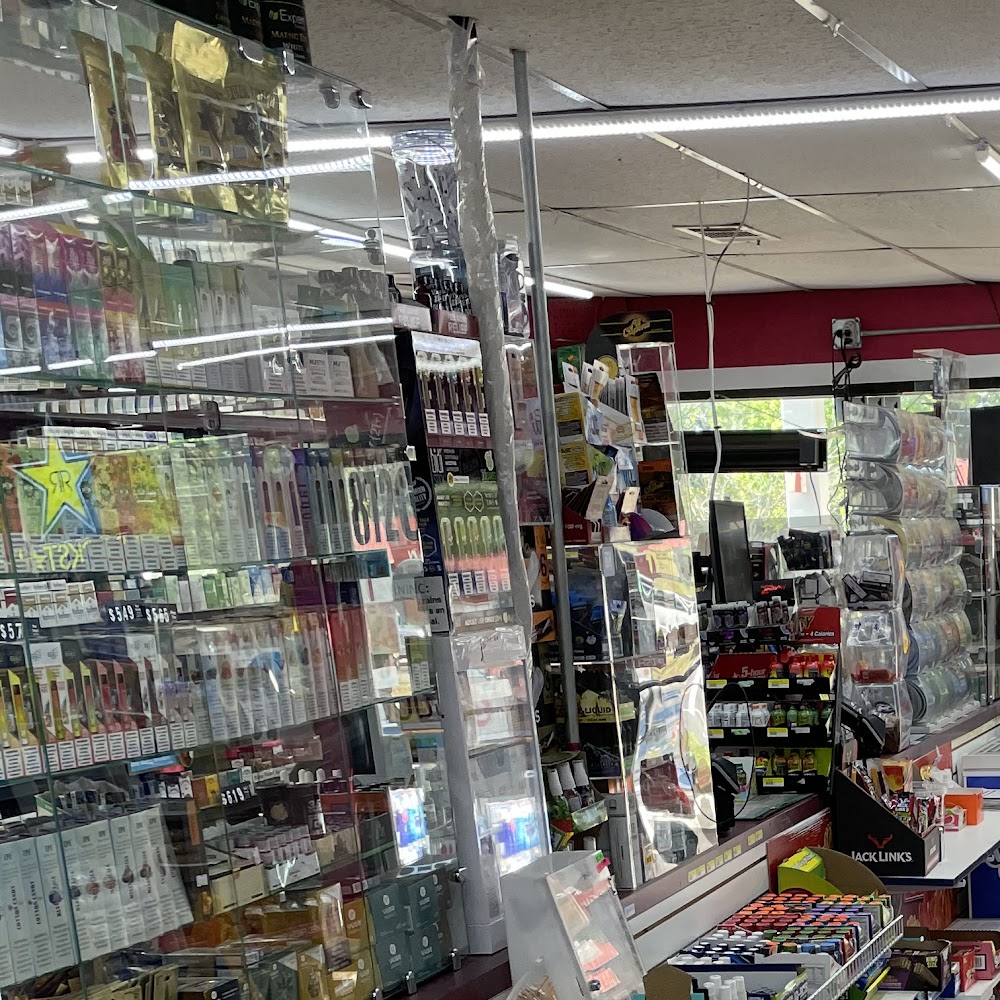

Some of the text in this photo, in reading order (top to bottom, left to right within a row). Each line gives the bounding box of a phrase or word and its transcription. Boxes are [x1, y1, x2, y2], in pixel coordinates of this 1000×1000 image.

[741, 666, 767, 677] 5-hour
[585, 706, 612, 715] LIQUID
[851, 850, 912, 862] JACK LINK'S
